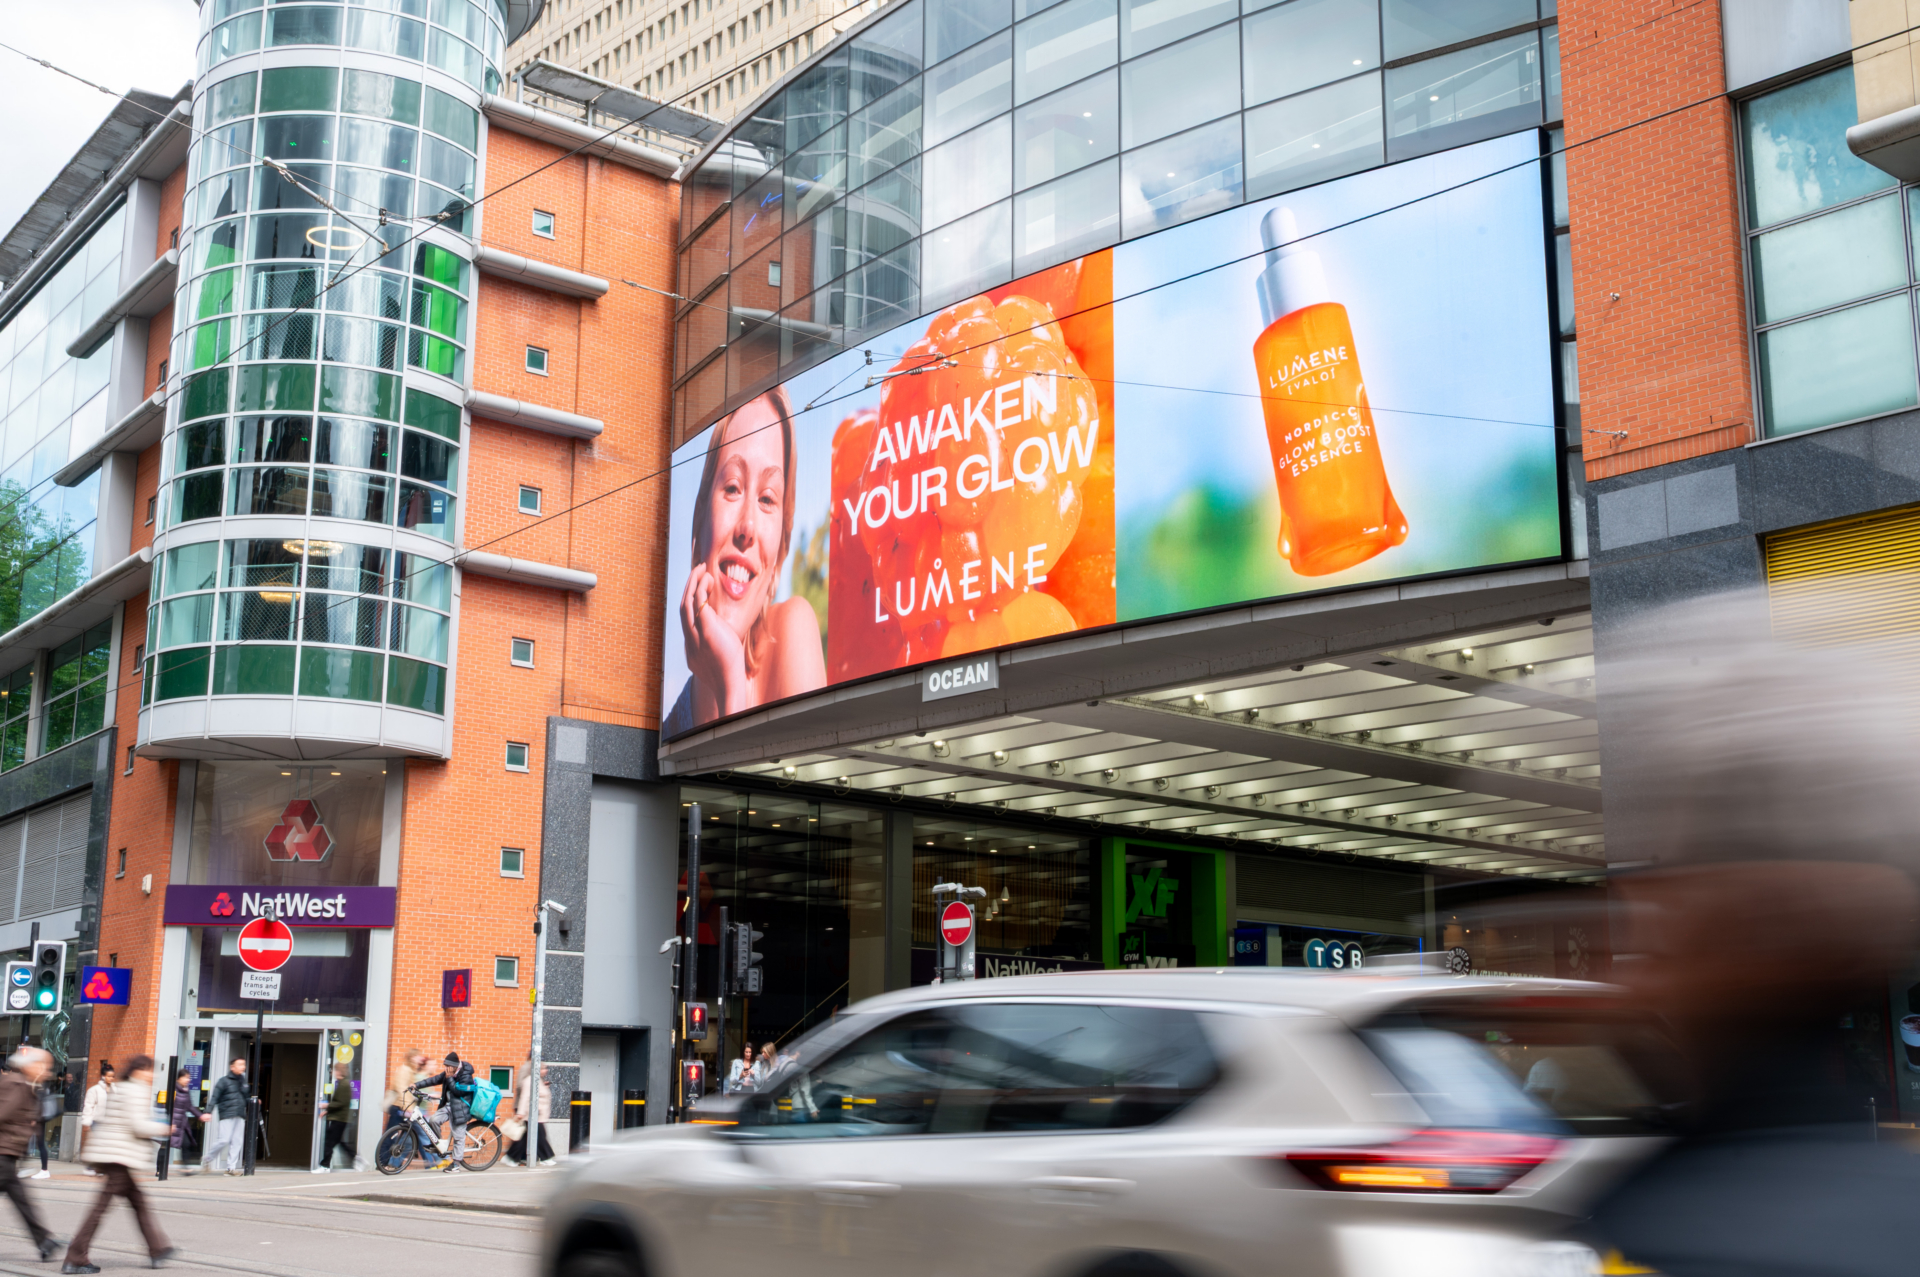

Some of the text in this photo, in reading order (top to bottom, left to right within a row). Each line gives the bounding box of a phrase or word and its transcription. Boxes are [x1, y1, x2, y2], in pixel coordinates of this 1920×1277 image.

[870, 369, 1057, 472] AWAKEN
[1279, 425, 1371, 469] GLOW BOOST
[1291, 441, 1362, 477] ESSENCE
[843, 419, 1099, 536] YOUR GLOW
[928, 662, 989, 692] OCEAN
[241, 892, 347, 918] NatWest
[1125, 867, 1179, 923] XF
[1124, 953, 1140, 961] GYM
[1313, 946, 1362, 970] TSB
[250, 974, 273, 982] Except
